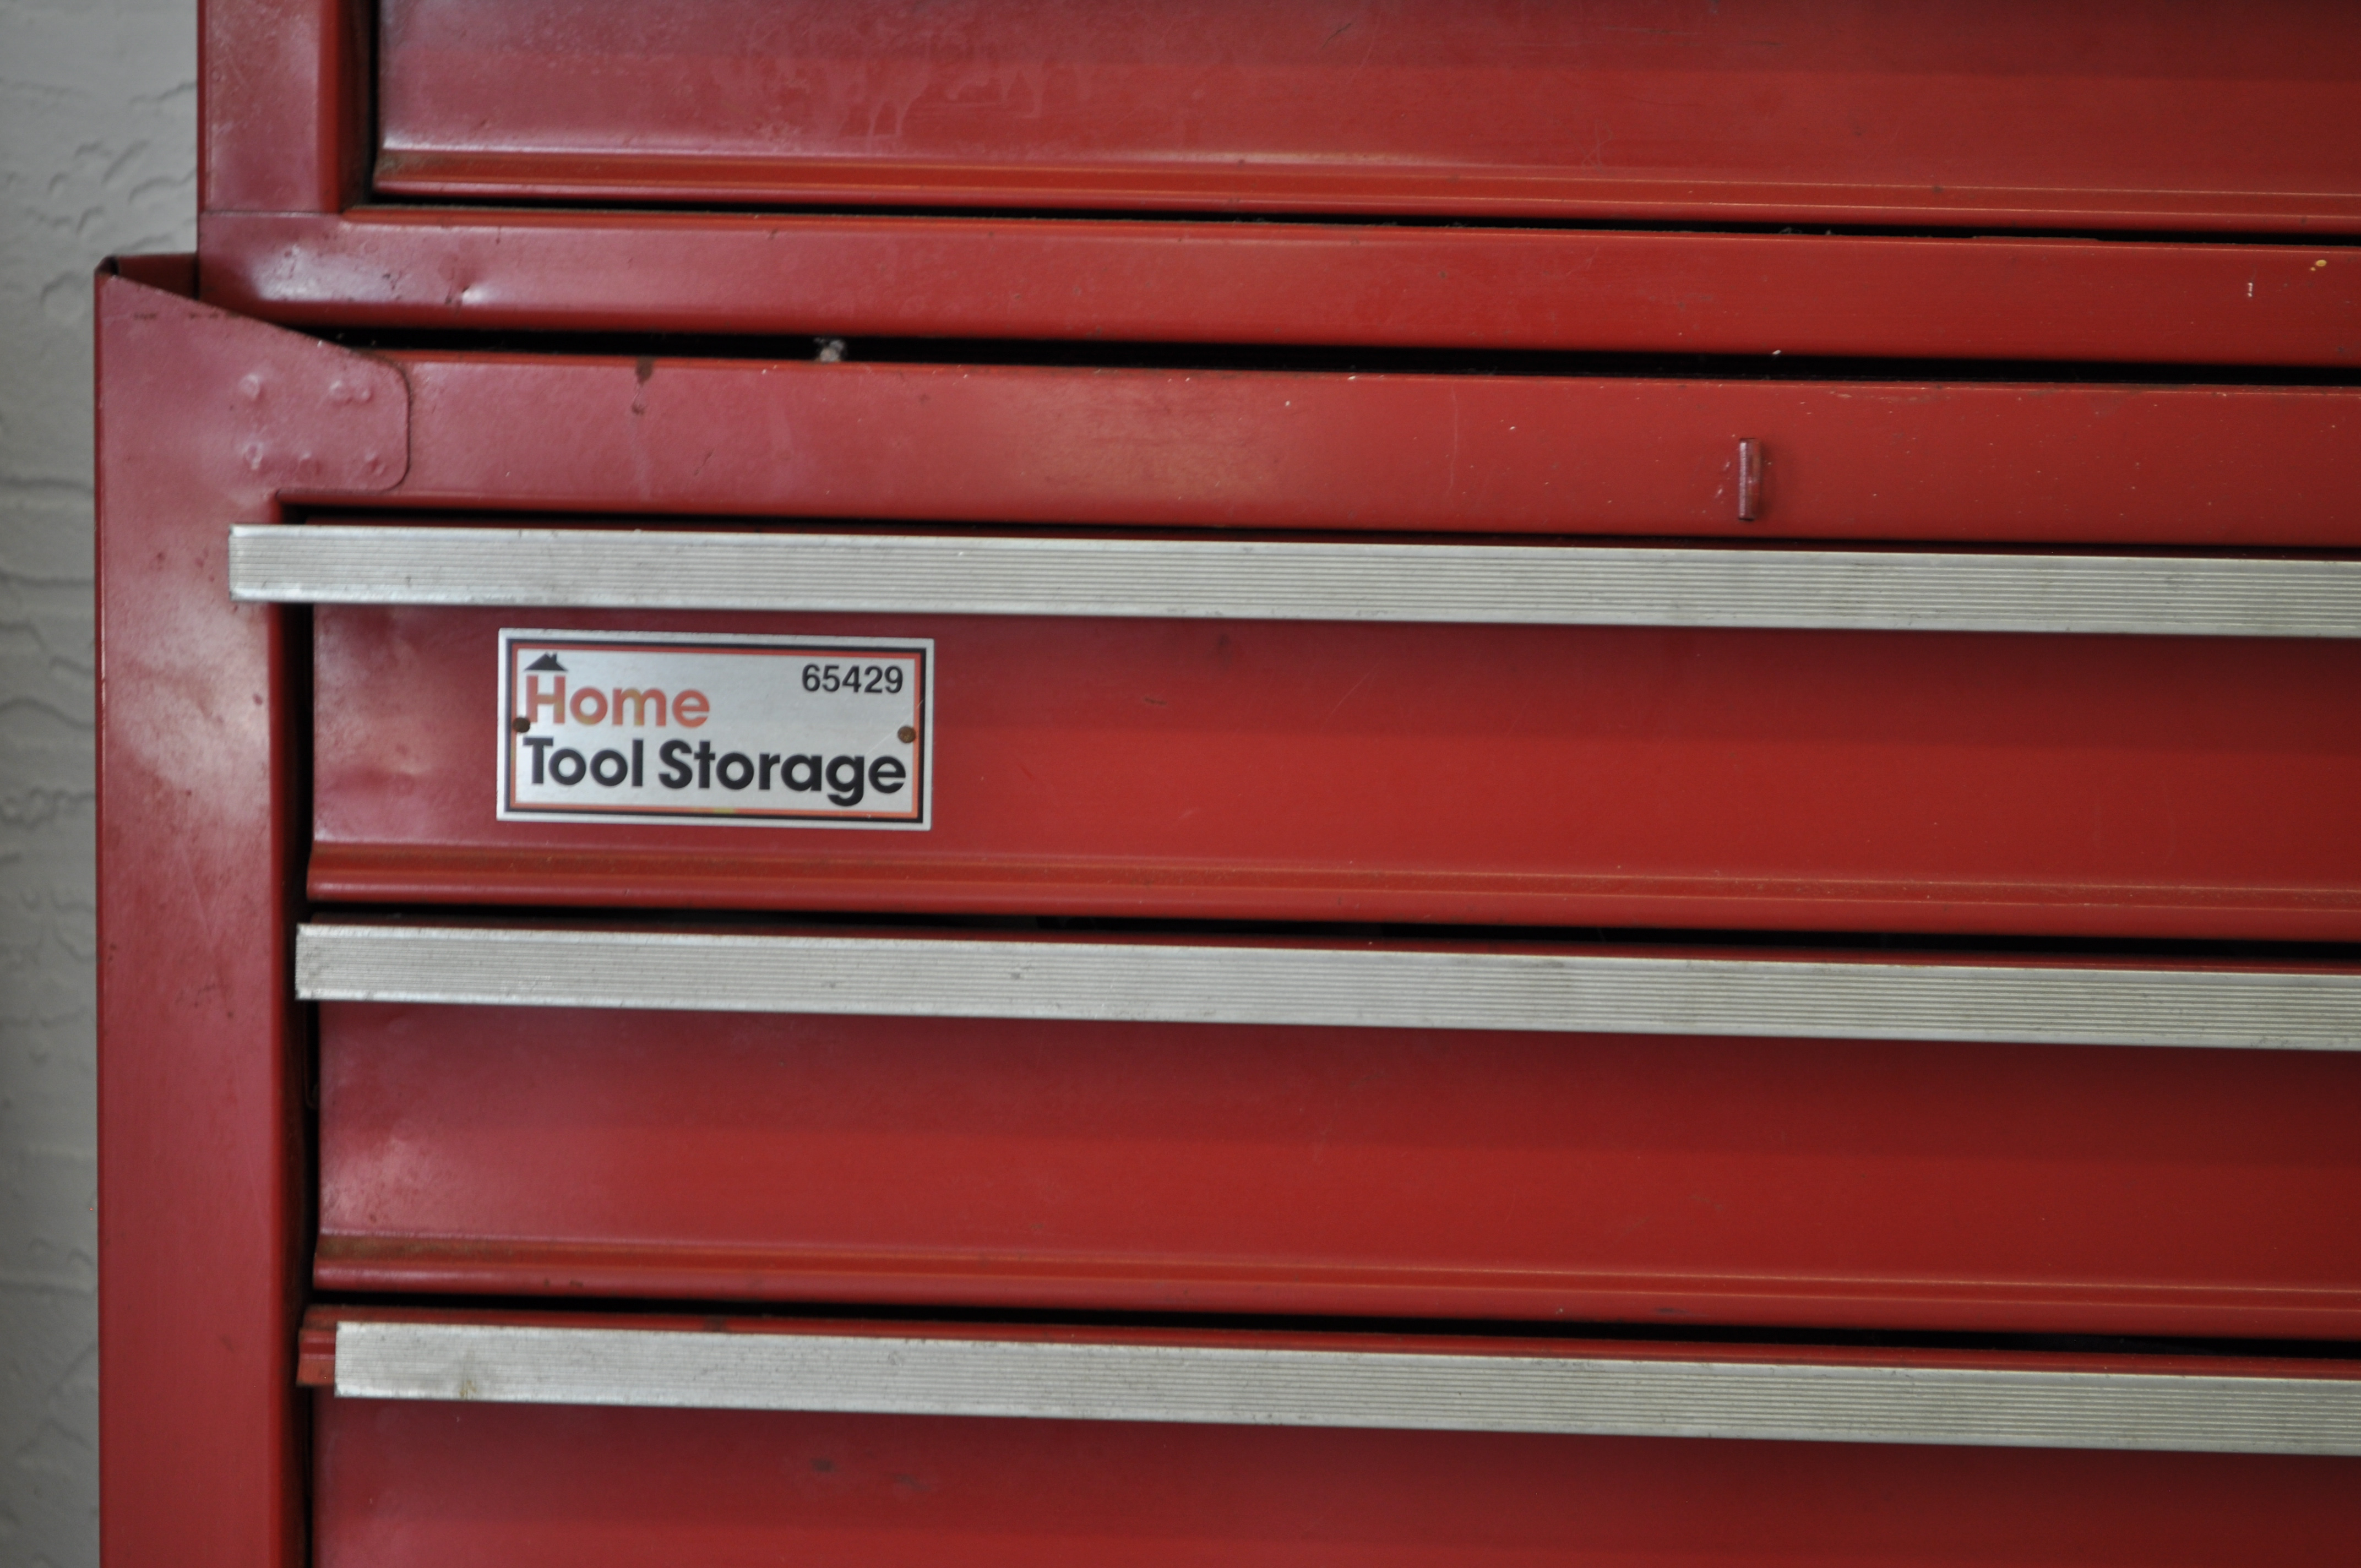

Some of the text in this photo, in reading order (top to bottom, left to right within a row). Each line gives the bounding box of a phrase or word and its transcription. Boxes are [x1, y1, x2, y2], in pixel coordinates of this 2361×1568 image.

[525, 675, 710, 727] Home
[802, 664, 904, 694] 65429
[523, 737, 906, 807] Tool Storage
